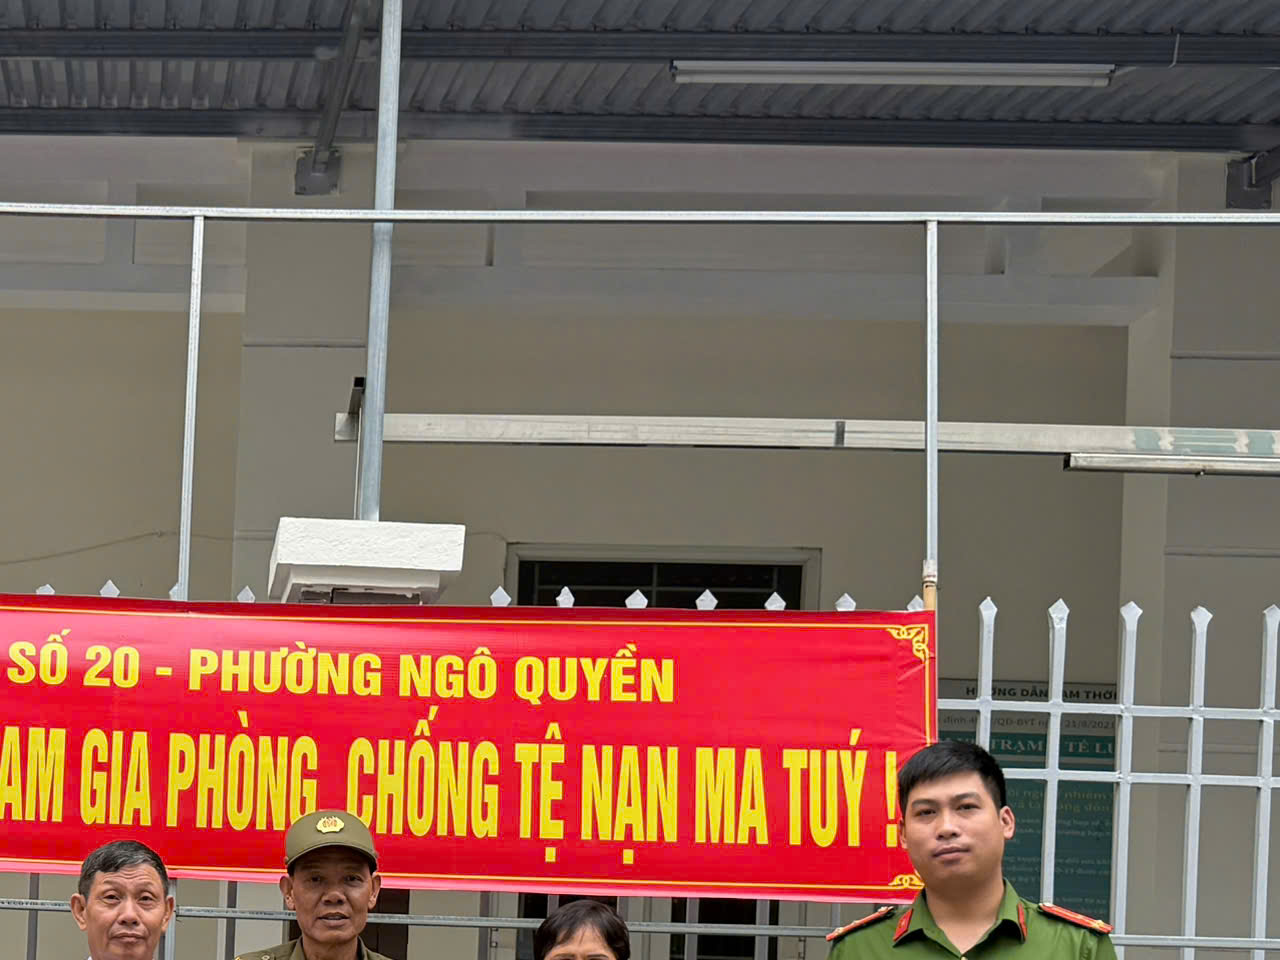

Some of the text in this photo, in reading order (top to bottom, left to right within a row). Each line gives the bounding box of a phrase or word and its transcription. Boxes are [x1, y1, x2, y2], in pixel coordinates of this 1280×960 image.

[7, 629, 72, 685] SỐ
[83, 645, 140, 688] 20
[155, 666, 172, 676] -
[189, 640, 382, 696] PHƯỜNG
[399, 646, 497, 699] NGÔ
[514, 643, 674, 705] QUYỀN
[80, 728, 152, 826] GIA
[166, 710, 318, 831] PHÒNG
[346, 705, 500, 839] CHỐNG
[514, 722, 566, 862] TỆ
[580, 744, 679, 865] NẠN
[694, 746, 769, 846] MA
[782, 728, 868, 848] TUÝ
